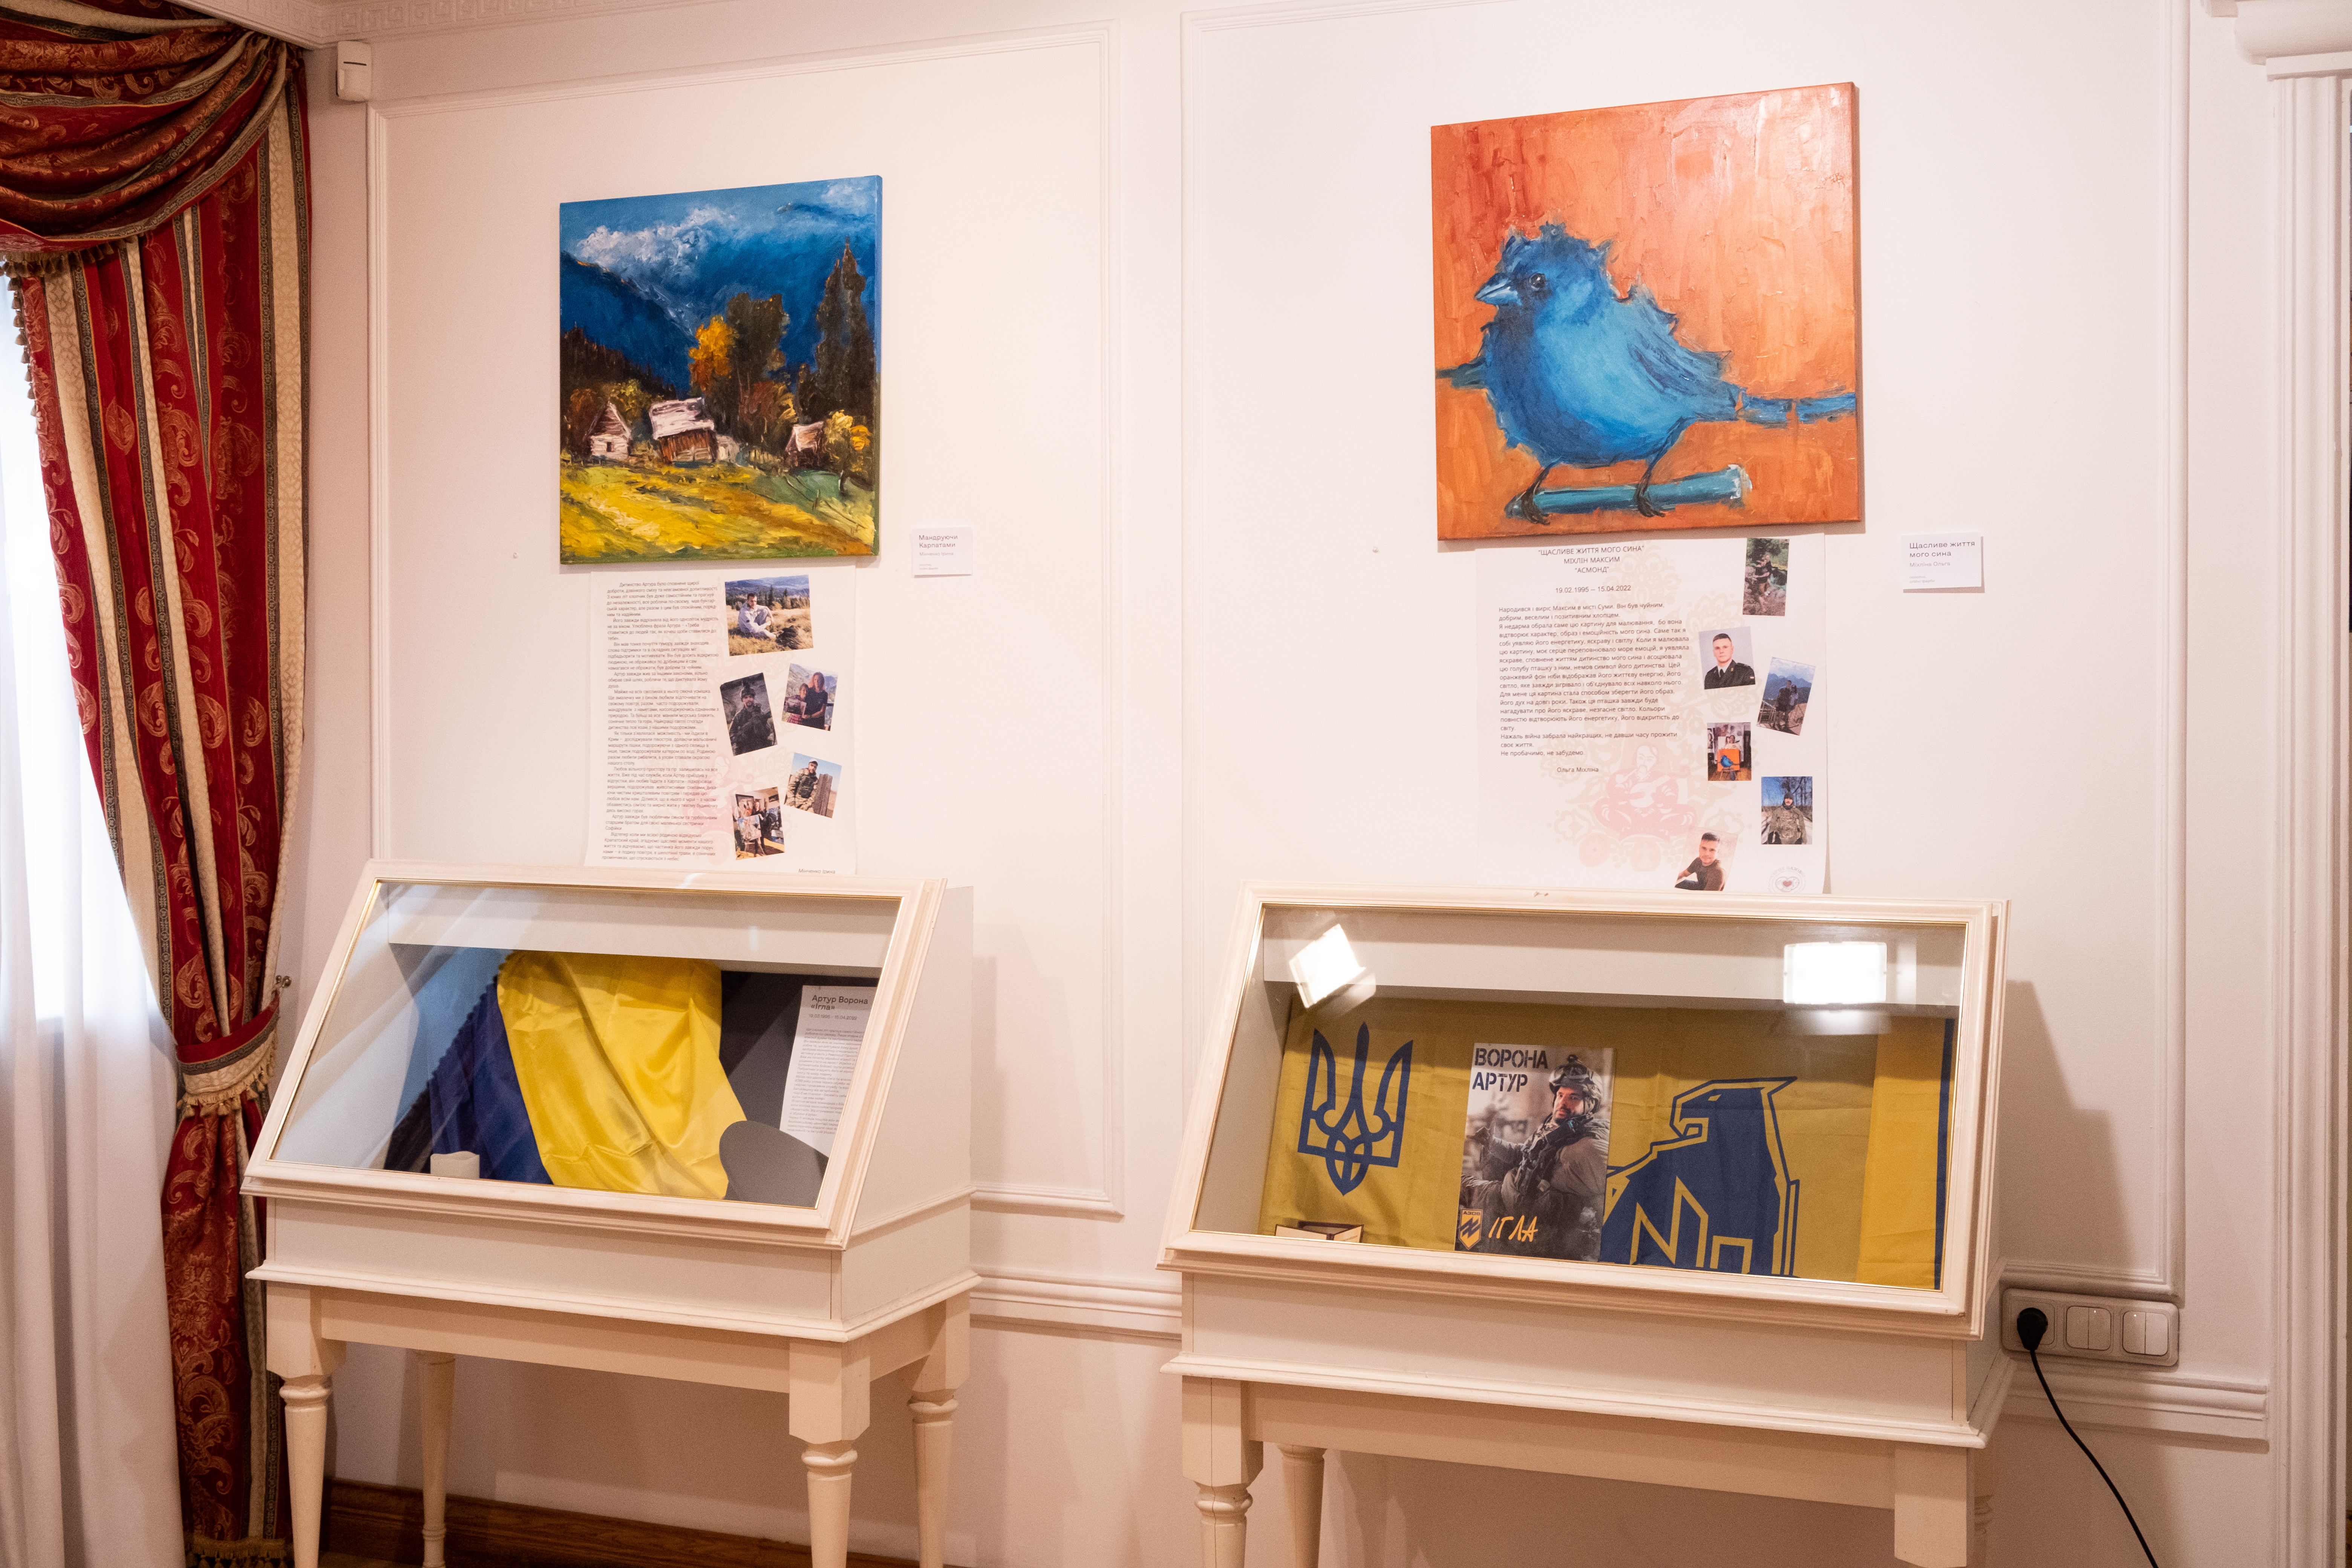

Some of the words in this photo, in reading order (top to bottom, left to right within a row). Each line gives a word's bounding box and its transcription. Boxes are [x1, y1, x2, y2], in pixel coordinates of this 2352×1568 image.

[1538, 548, 1574, 556] "ЩАСЛИВЕ
[812, 995, 836, 1004] Артур
[839, 996, 868, 1004] Ворона
[1474, 1048, 1548, 1069] ВОРОНА
[1472, 1072, 1528, 1092] АРТУР
[1488, 1214, 1539, 1242] ІГЛА
